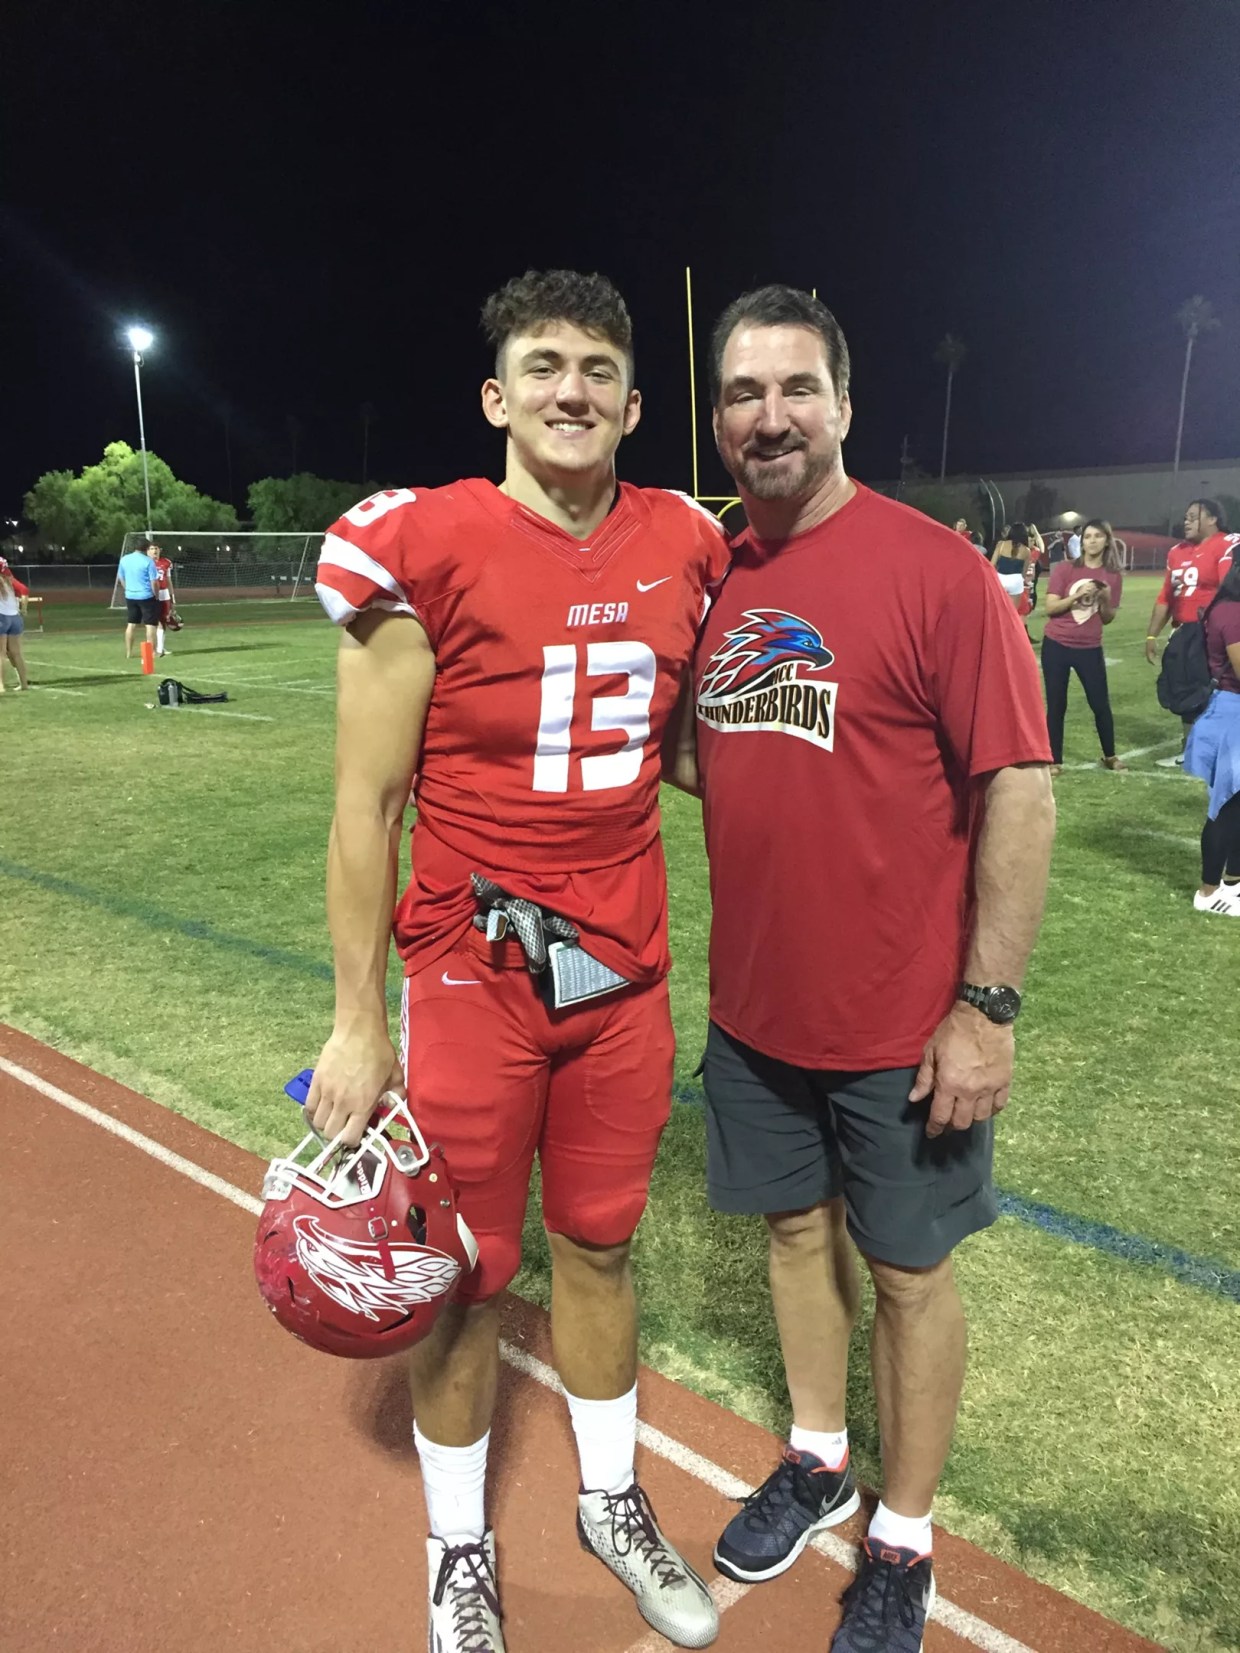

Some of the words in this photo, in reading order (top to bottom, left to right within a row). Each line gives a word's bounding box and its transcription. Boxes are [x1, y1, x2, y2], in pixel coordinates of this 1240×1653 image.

[566, 601, 629, 627] MESA
[533, 640, 657, 793] 13
[697, 684, 831, 739] THUNDERBIRDS
